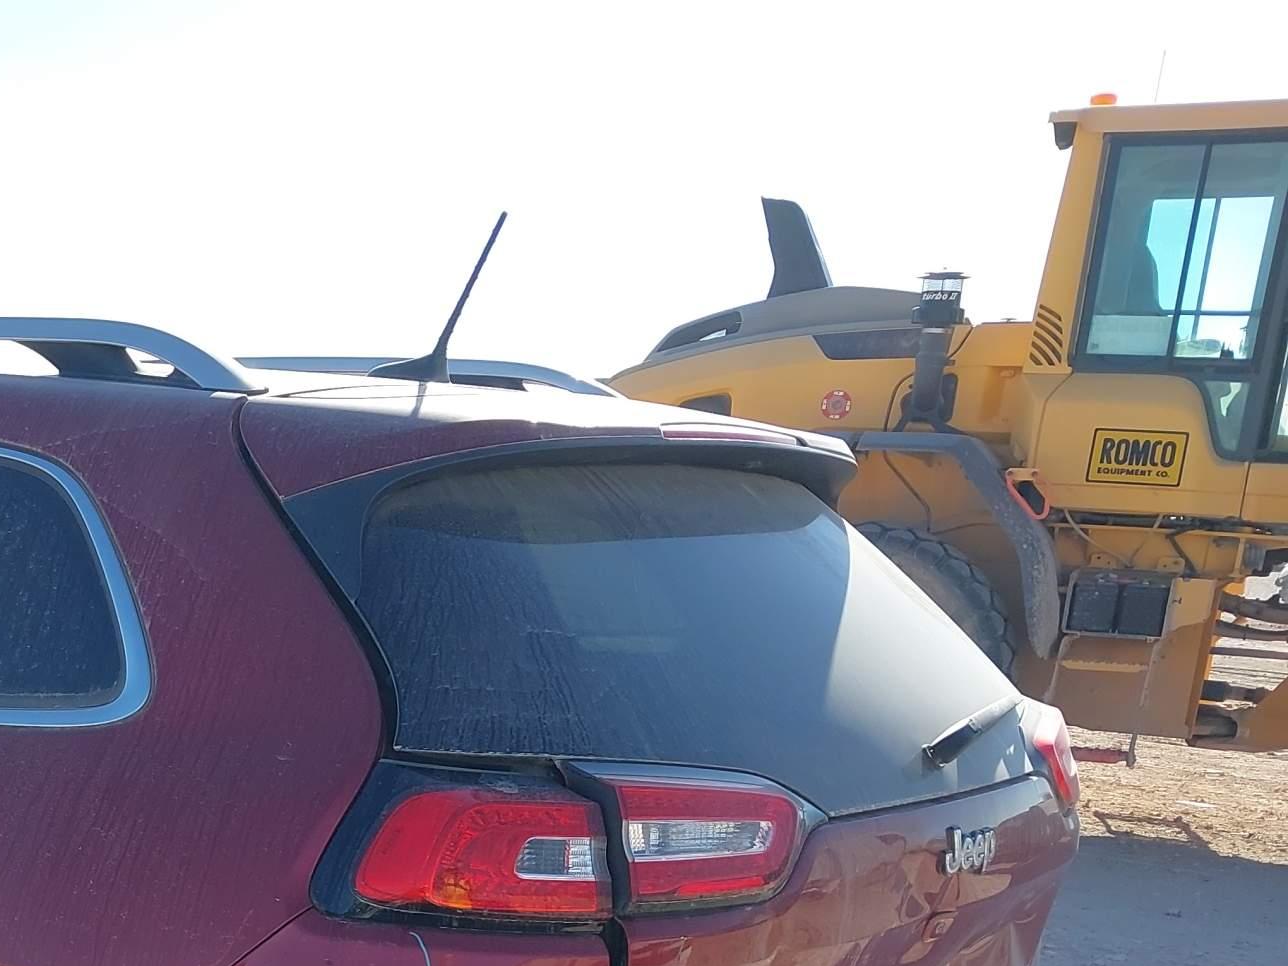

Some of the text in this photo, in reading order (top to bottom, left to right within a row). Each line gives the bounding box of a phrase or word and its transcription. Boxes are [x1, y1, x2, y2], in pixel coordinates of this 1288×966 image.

[922, 291, 948, 301] turbo
[1099, 437, 1177, 468] ROMCO
[1096, 466, 1170, 478] EQUIPMENT CO.
[941, 826, 996, 874] Jeep
